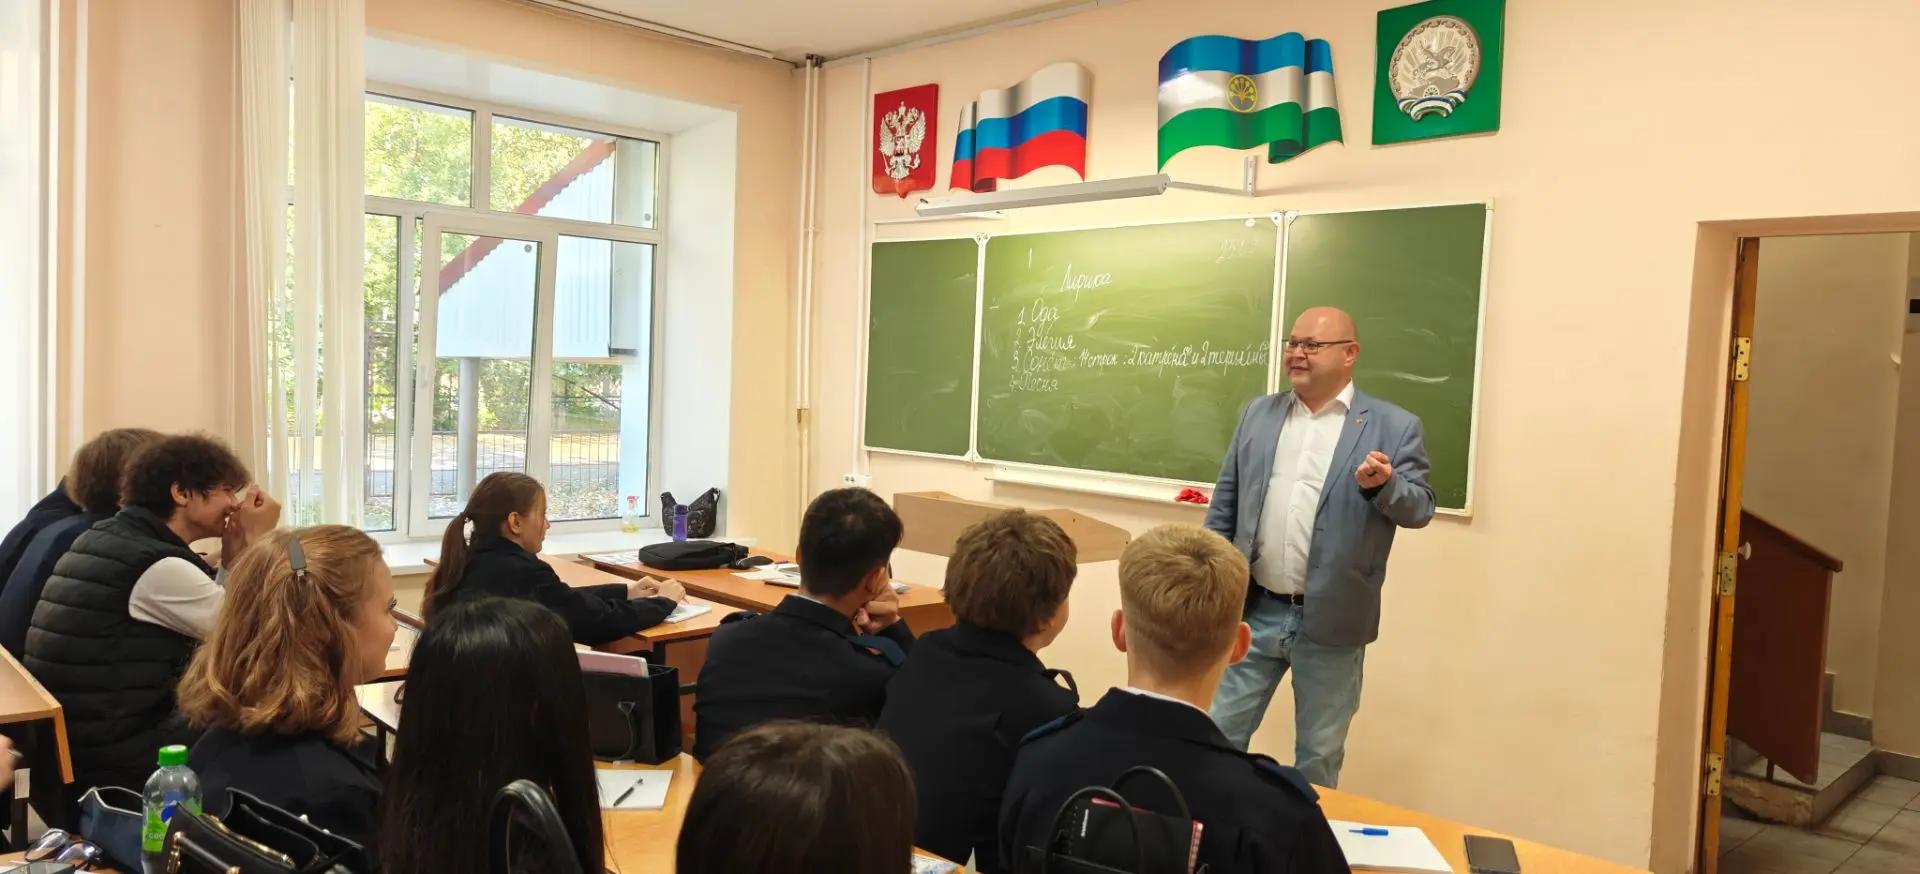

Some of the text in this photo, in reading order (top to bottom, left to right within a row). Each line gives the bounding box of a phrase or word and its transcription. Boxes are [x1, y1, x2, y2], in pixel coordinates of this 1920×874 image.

[1060, 263, 1112, 303] Лирика
[1031, 297, 1060, 337] Ода
[1027, 326, 1077, 351] Элегия
[1018, 371, 1059, 392] Песня
